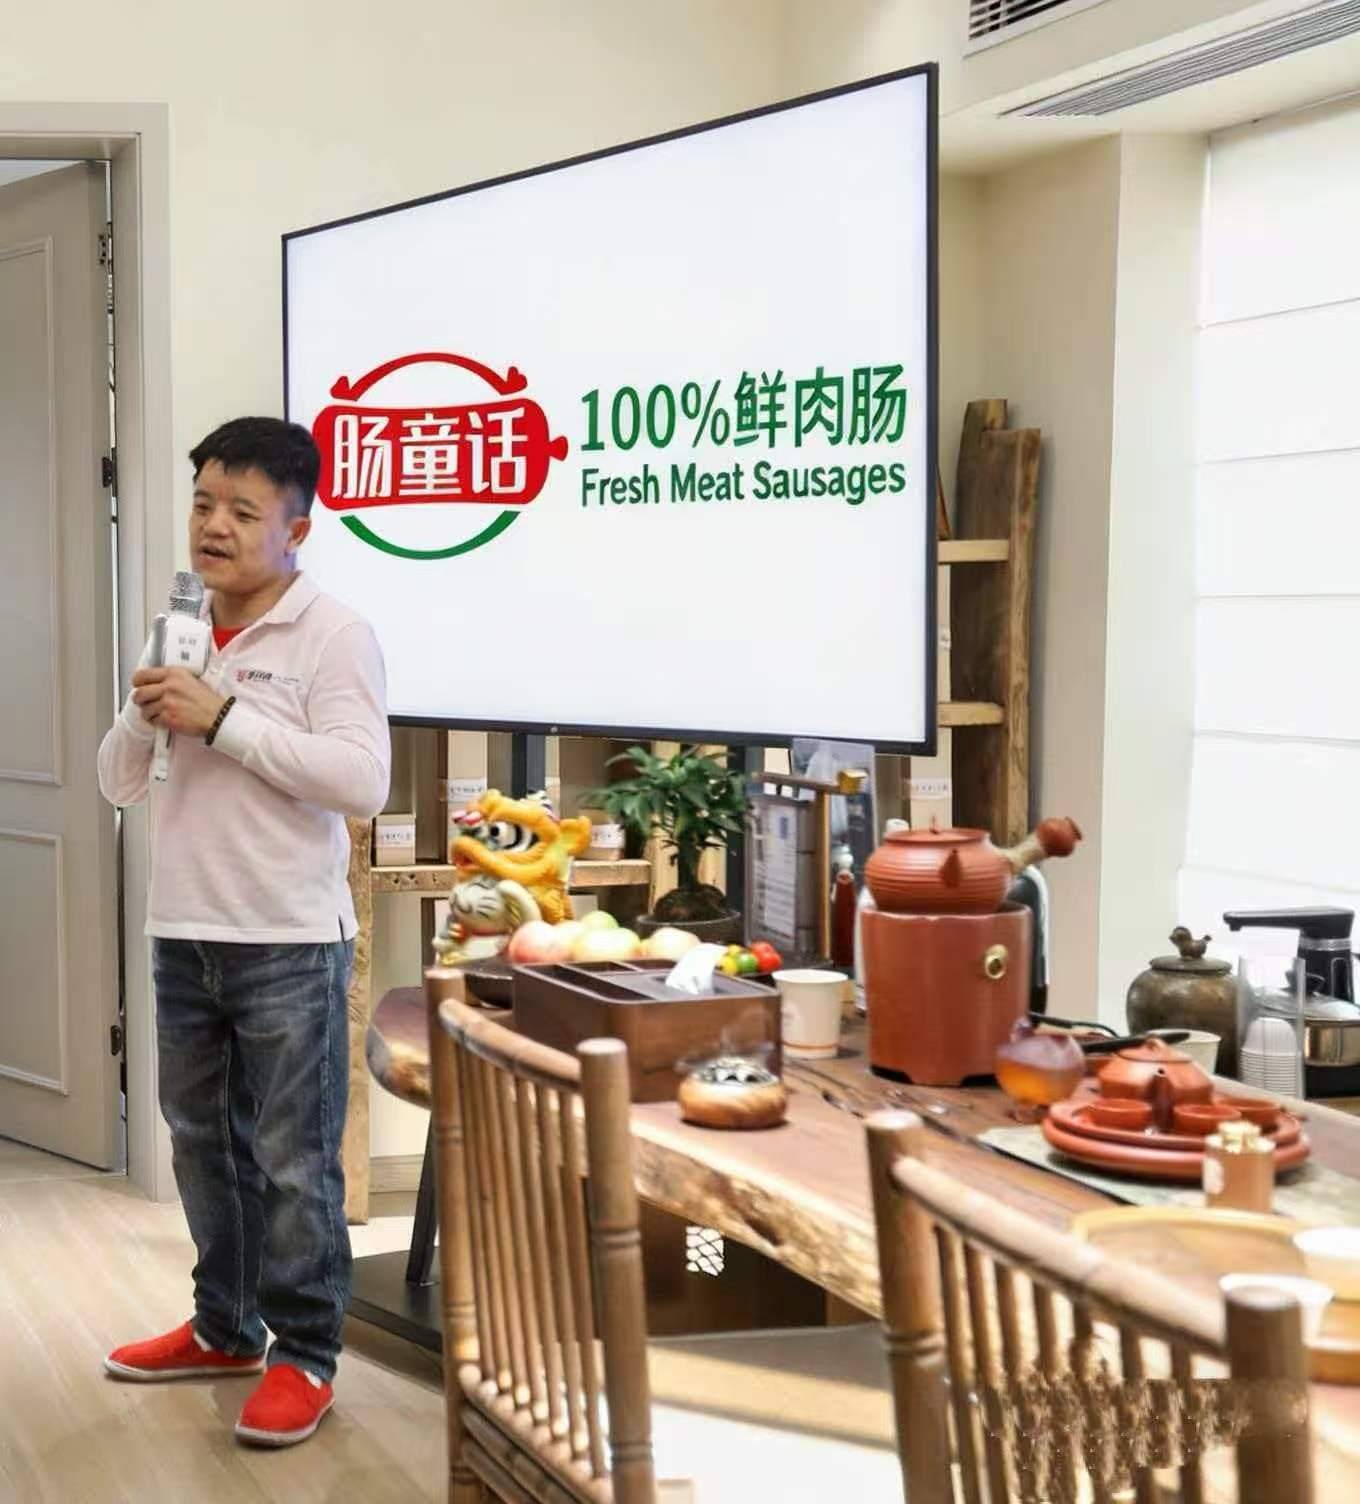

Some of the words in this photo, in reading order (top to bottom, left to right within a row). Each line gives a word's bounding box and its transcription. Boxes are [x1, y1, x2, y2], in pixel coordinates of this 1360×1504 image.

[580, 363, 908, 451] 100%鲜肉肠
[331, 407, 529, 499] 肠童话
[581, 463, 660, 507] Fresh
[670, 462, 745, 503] Meat
[752, 460, 907, 505] Sausages
